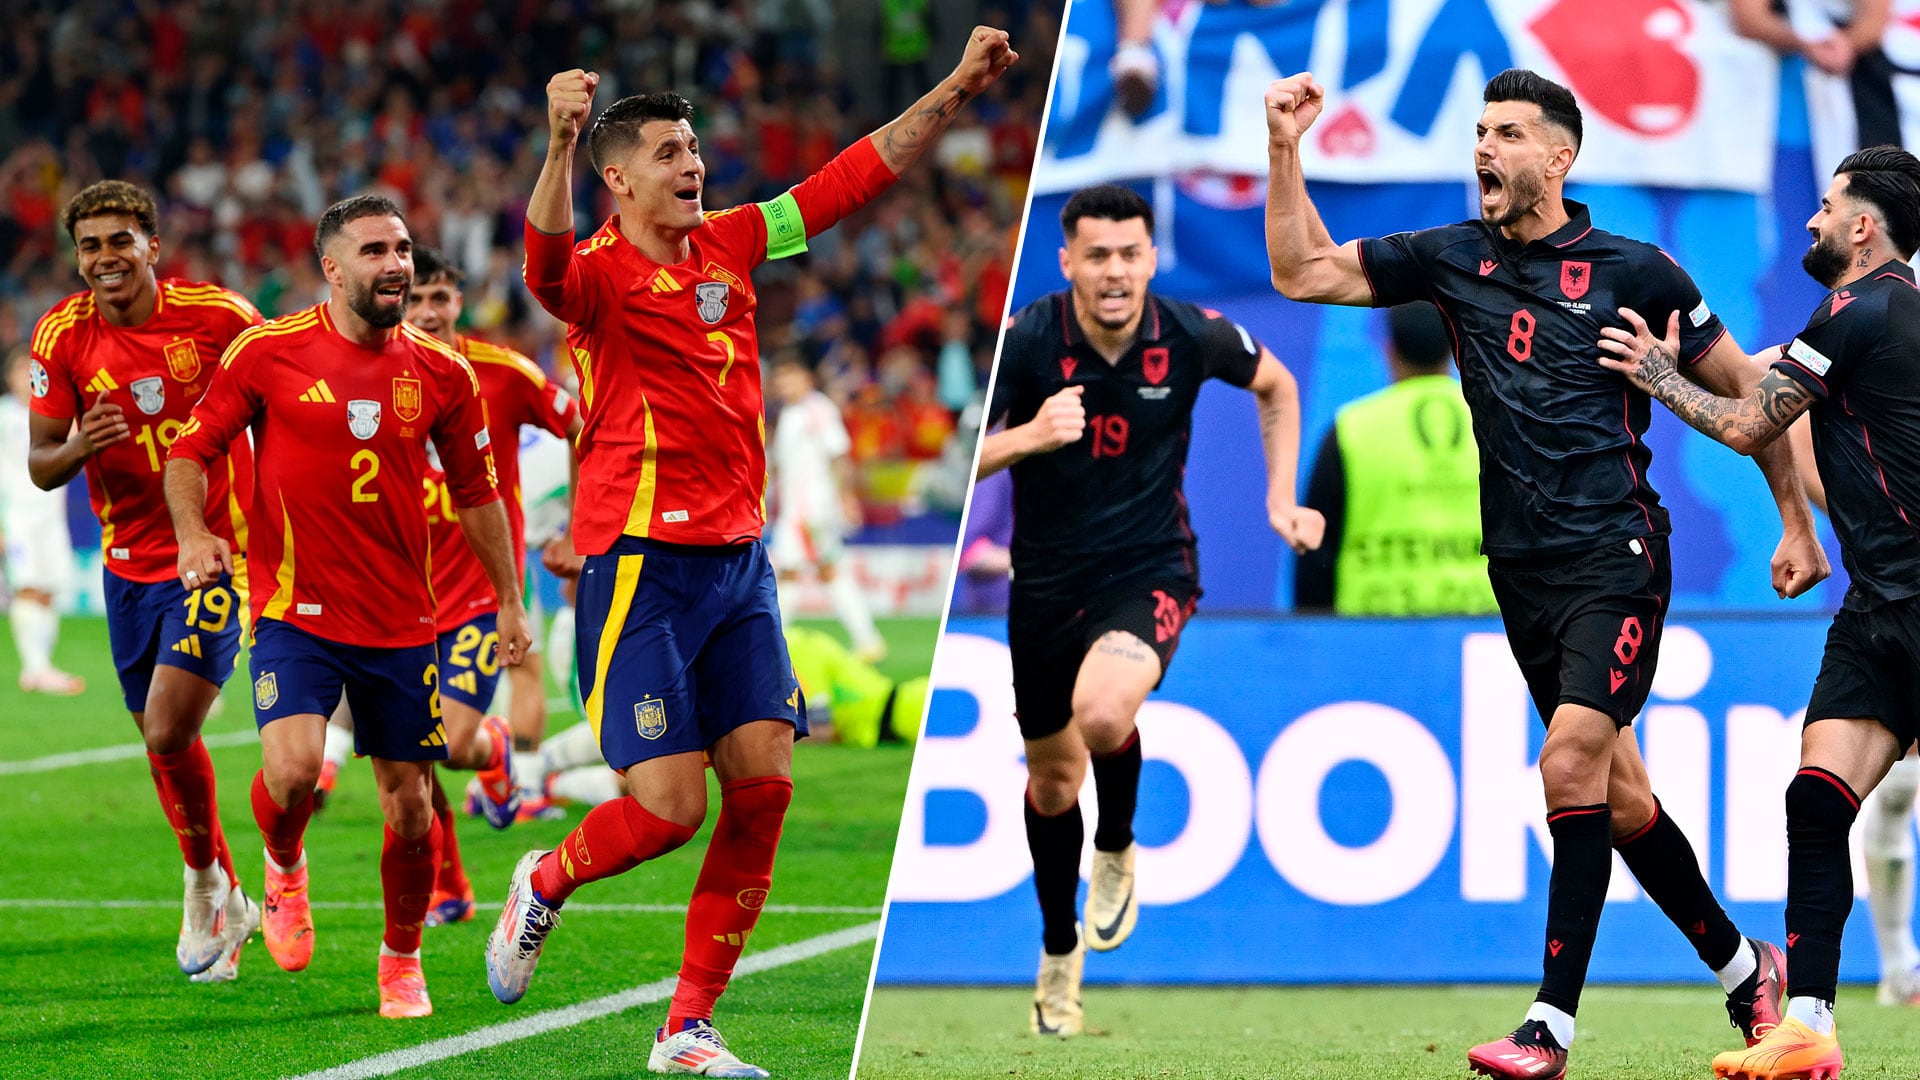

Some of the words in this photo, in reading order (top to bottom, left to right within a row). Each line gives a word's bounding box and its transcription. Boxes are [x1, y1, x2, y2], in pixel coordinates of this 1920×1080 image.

[706, 331, 735, 386] 7
[1507, 308, 1537, 363] 8
[1090, 414, 1129, 459] 19
[350, 449, 380, 503] 2
[183, 586, 232, 633] 19
[448, 625, 499, 677] 20
[1613, 616, 1643, 665] 8
[423, 663, 442, 719] 2
